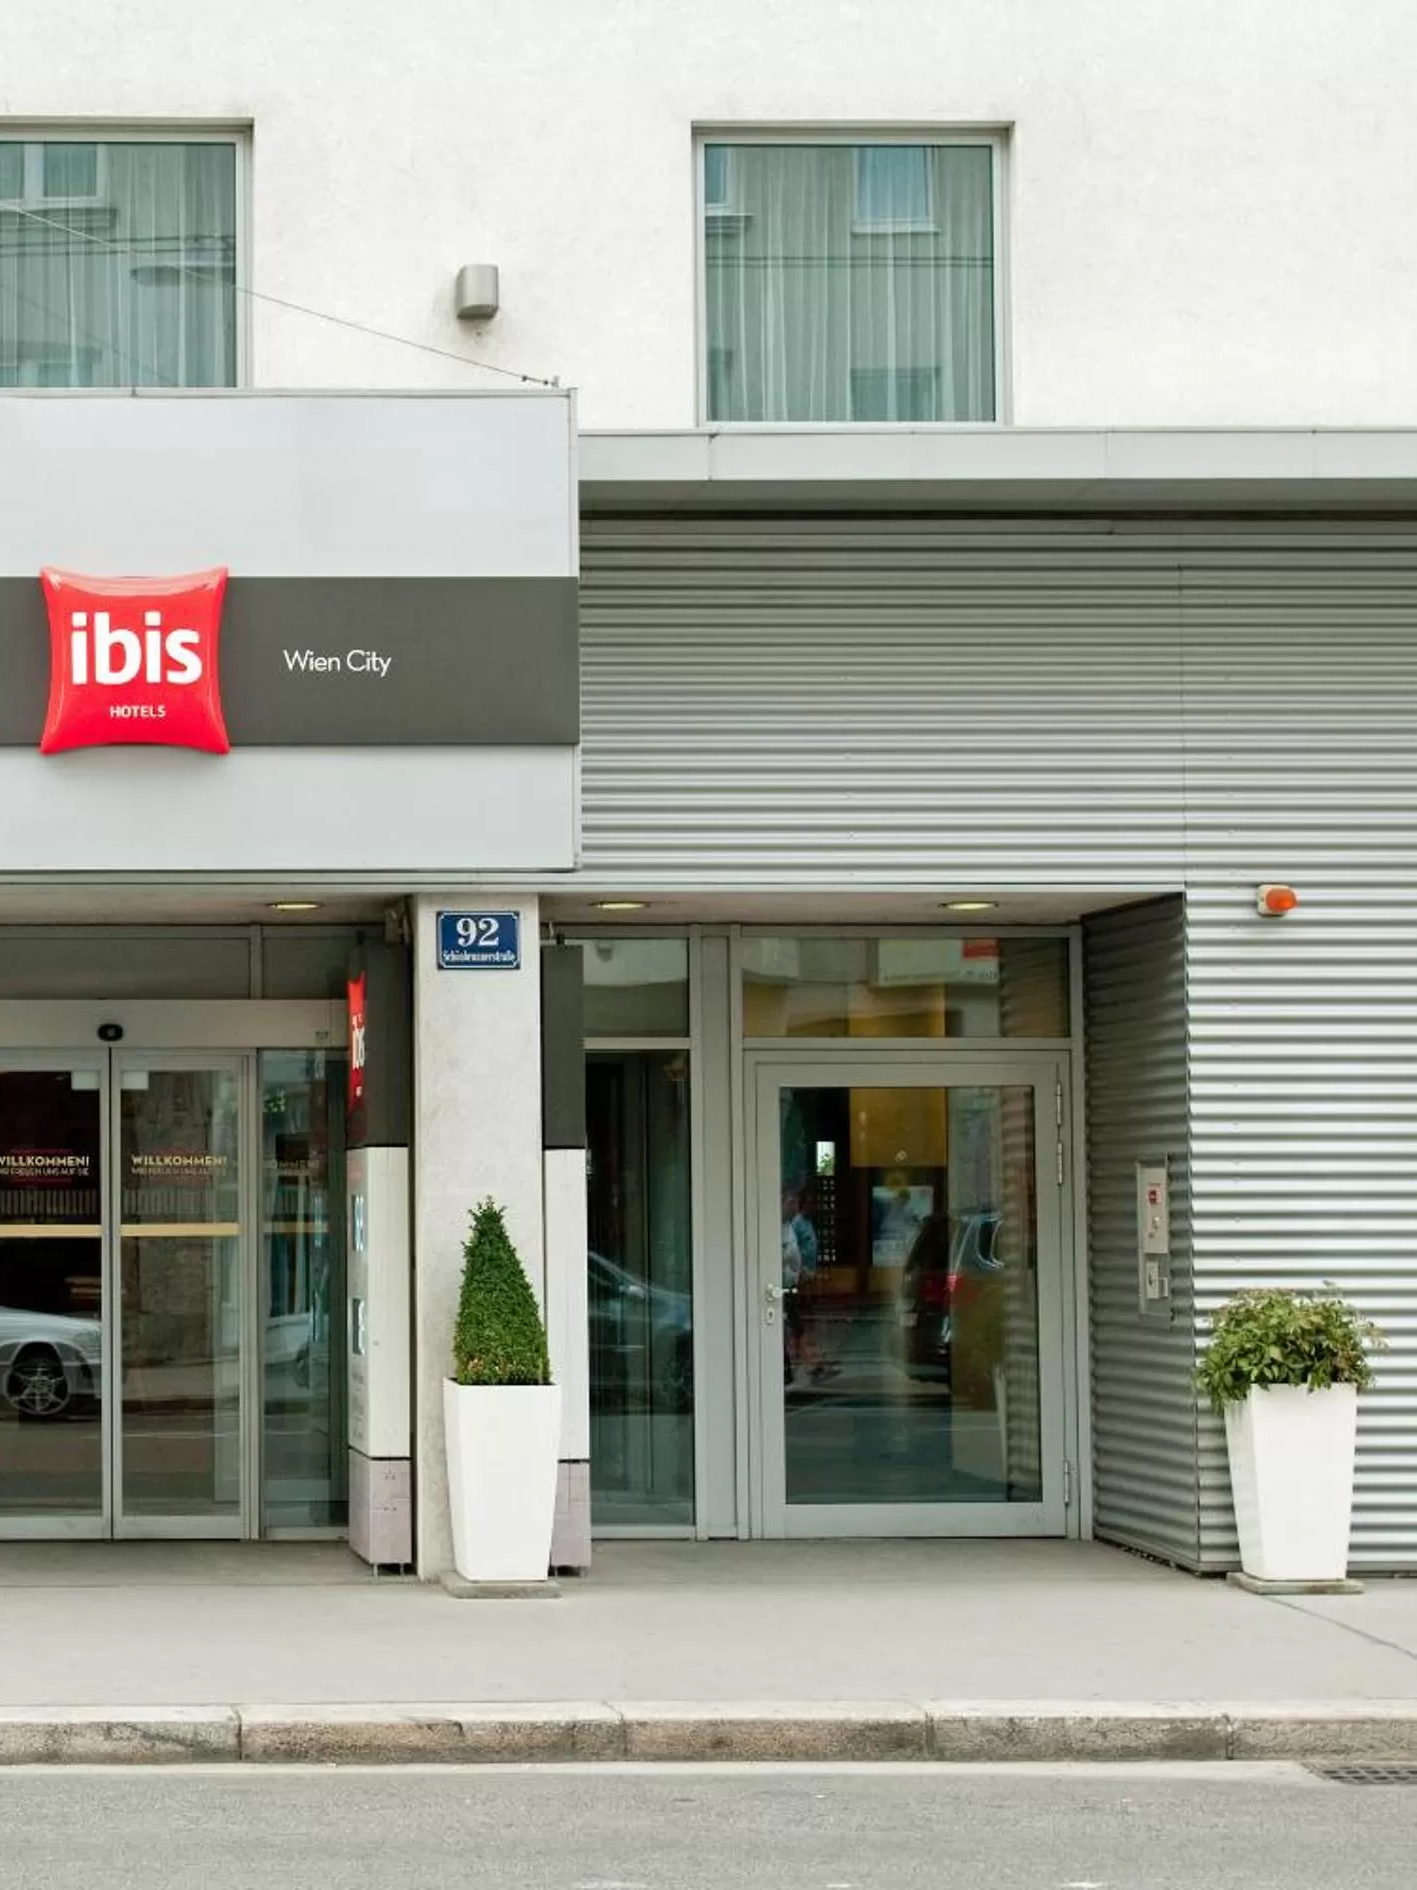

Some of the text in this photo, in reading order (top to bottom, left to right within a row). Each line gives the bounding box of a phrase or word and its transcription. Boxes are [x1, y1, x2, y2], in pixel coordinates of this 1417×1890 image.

[71, 611, 203, 685] ibis
[283, 649, 392, 678] Wien City
[109, 704, 167, 718] HOTELS
[456, 917, 500, 947] 92
